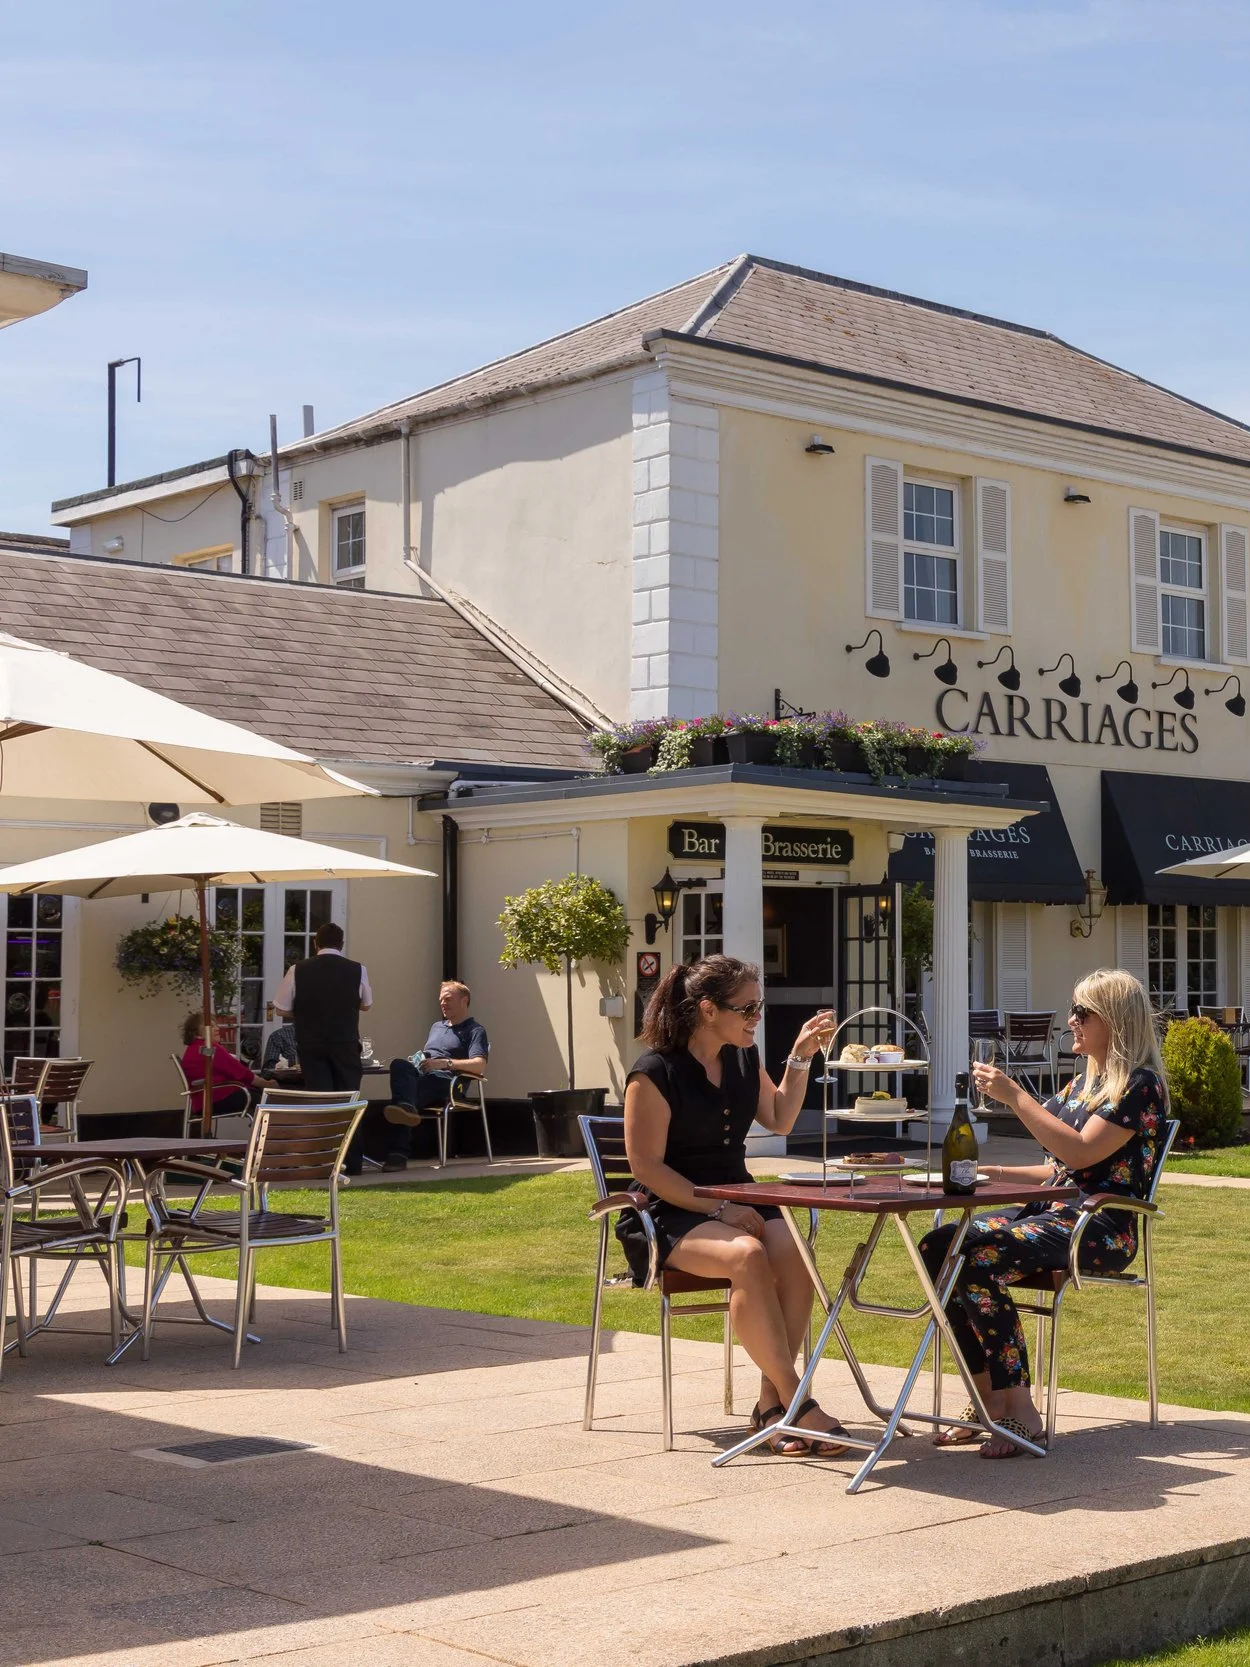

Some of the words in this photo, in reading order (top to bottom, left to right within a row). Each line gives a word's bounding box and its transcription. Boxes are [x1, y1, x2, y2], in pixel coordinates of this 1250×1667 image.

[935, 688, 1199, 754] CARRIAGES
[681, 828, 720, 854] Bar
[761, 832, 842, 859] Brasserie
[968, 849, 1020, 859] BRASSERIE
